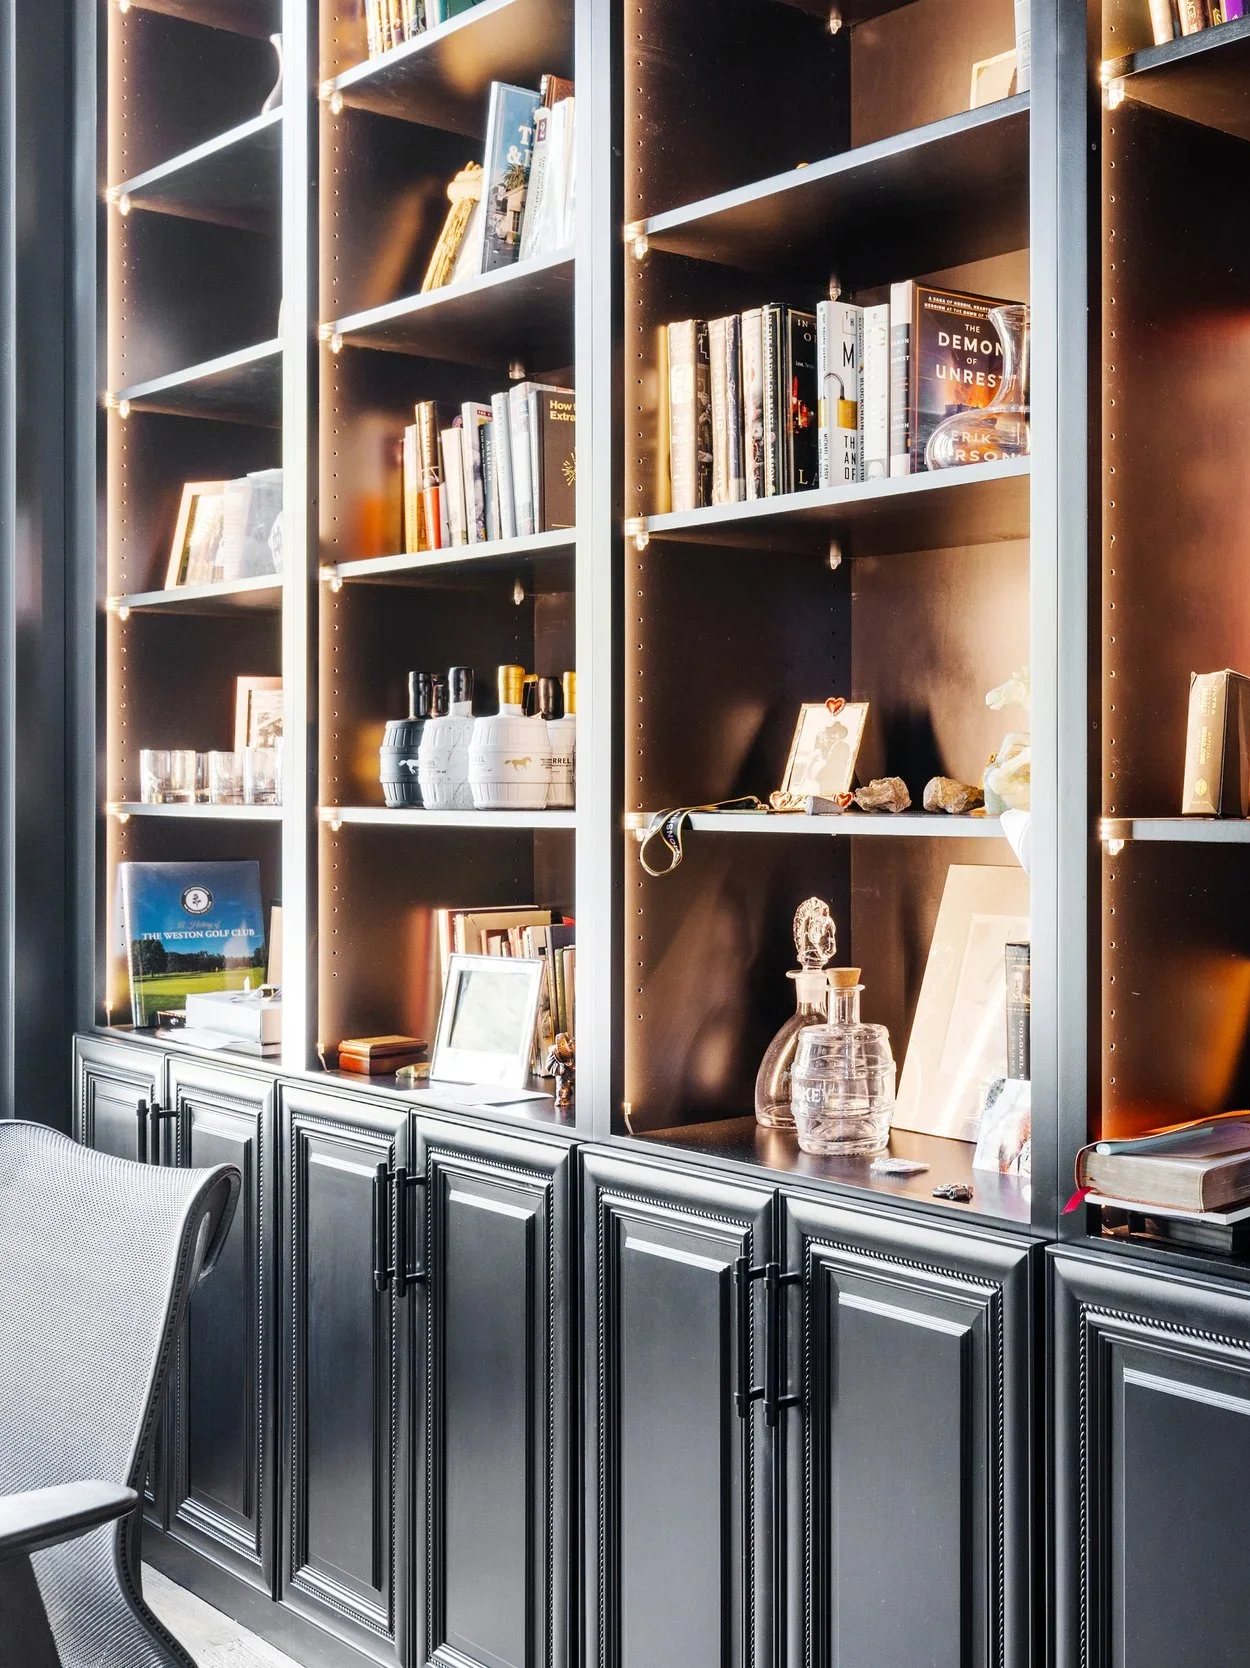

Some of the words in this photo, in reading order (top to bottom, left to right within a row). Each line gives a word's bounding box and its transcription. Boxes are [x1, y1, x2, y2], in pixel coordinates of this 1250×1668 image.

[539, 122, 546, 138] 2
[797, 318, 809, 329] IN
[964, 323, 981, 334] THE
[938, 331, 1006, 356] DEMON
[843, 341, 855, 369] M
[966, 357, 978, 365] OF
[550, 400, 573, 411] How
[550, 410, 576, 422] Extra
[951, 430, 992, 445] ERIK
[141, 932, 163, 941] THE
[163, 930, 204, 940] WESTON
[205, 929, 230, 938] GOLF
[231, 928, 255, 937] CLUB
